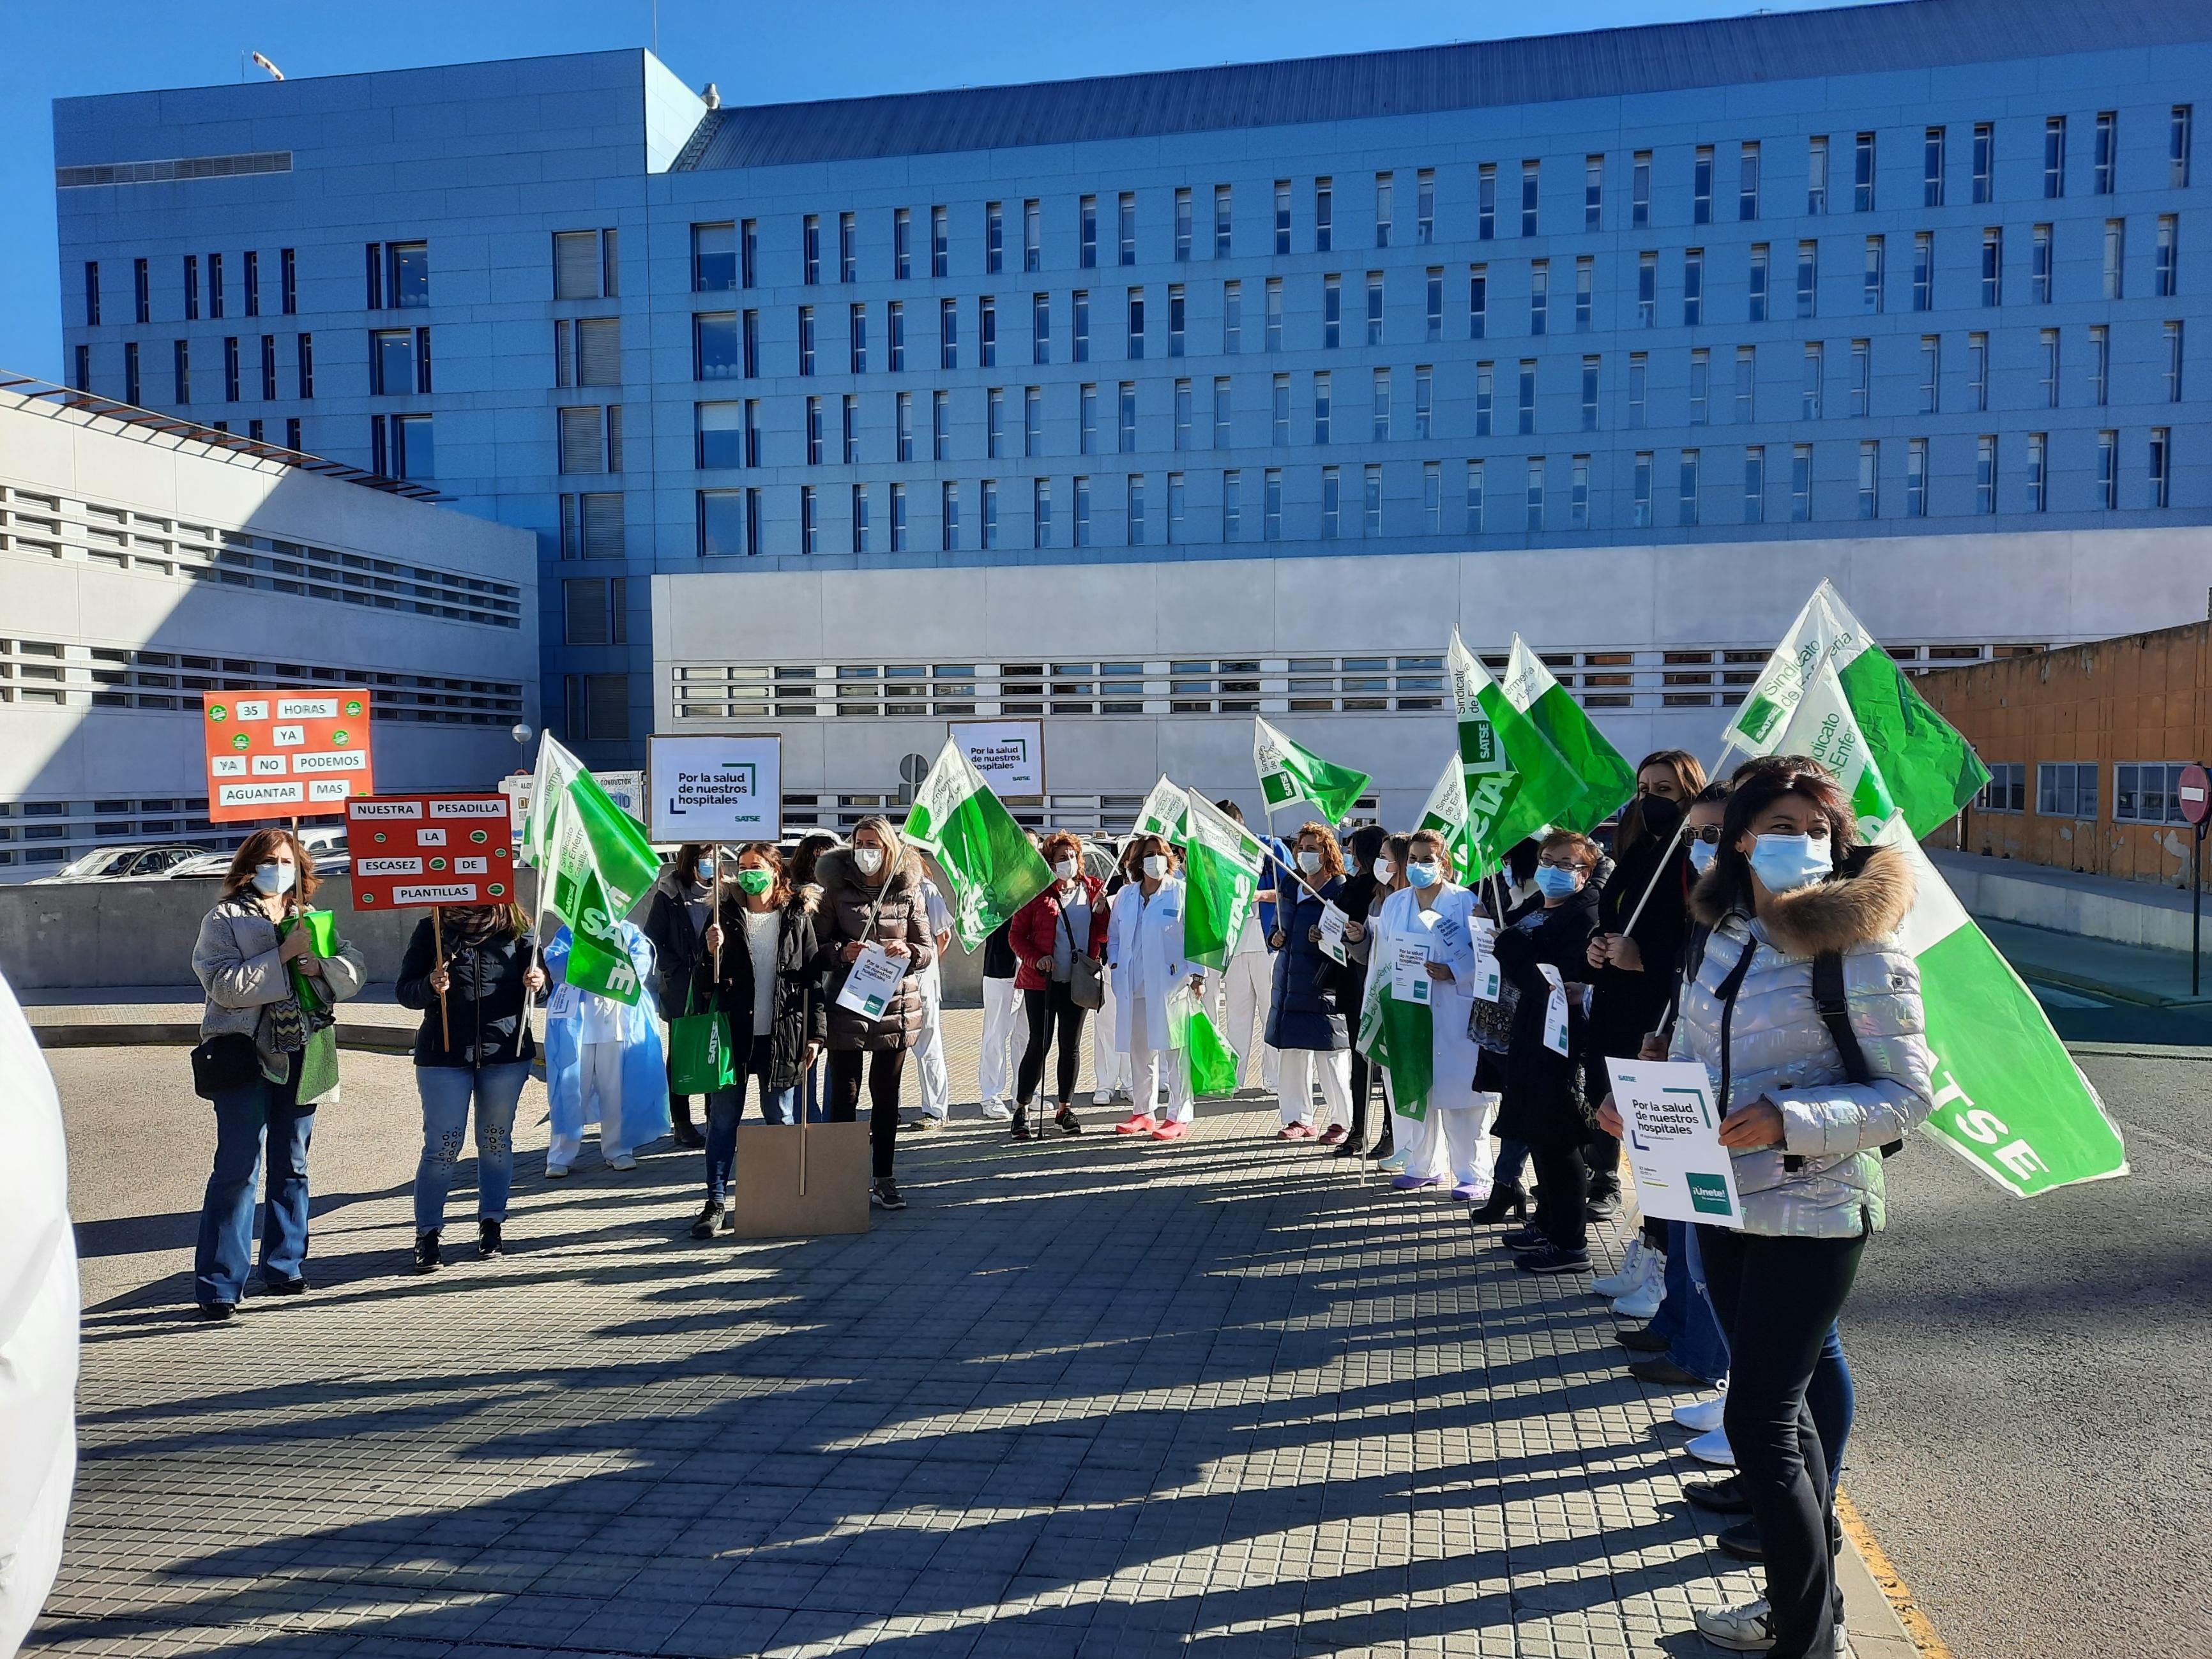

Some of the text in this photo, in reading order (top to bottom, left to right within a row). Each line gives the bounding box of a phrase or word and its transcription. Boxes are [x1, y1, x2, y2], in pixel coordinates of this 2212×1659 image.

[1764, 640, 1820, 696] Sindicato
[1505, 667, 1534, 695] ermería
[243, 704, 326, 716] 35 HORAS
[1469, 700, 1480, 713] de
[1756, 705, 1780, 739] SATSE
[280, 731, 297, 740] YA
[1478, 723, 1490, 759] SATSE
[1810, 713, 1840, 761] ndicato
[220, 755, 360, 771] YA NO PODEMOS
[678, 773, 745, 782] Por la salud
[226, 784, 343, 800] AGUANTAR MAS
[678, 784, 747, 793] de nuestros
[678, 794, 738, 807] hospitales
[358, 803, 500, 815] NUESTRA PESADILLA
[1445, 806, 1454, 816] de
[425, 833, 439, 841] LA
[365, 860, 478, 870] ESCASEZ DE
[400, 887, 469, 898] PLANTILLAS
[566, 883, 575, 915] SATSE
[1632, 1098, 1694, 1113] Por la salud
[1635, 1110, 1699, 1124] de nuestros
[1931, 1066, 2050, 1181] TSE
[1637, 1121, 1693, 1135] hospitales
[1692, 1185, 1726, 1198] ¡Únete!
